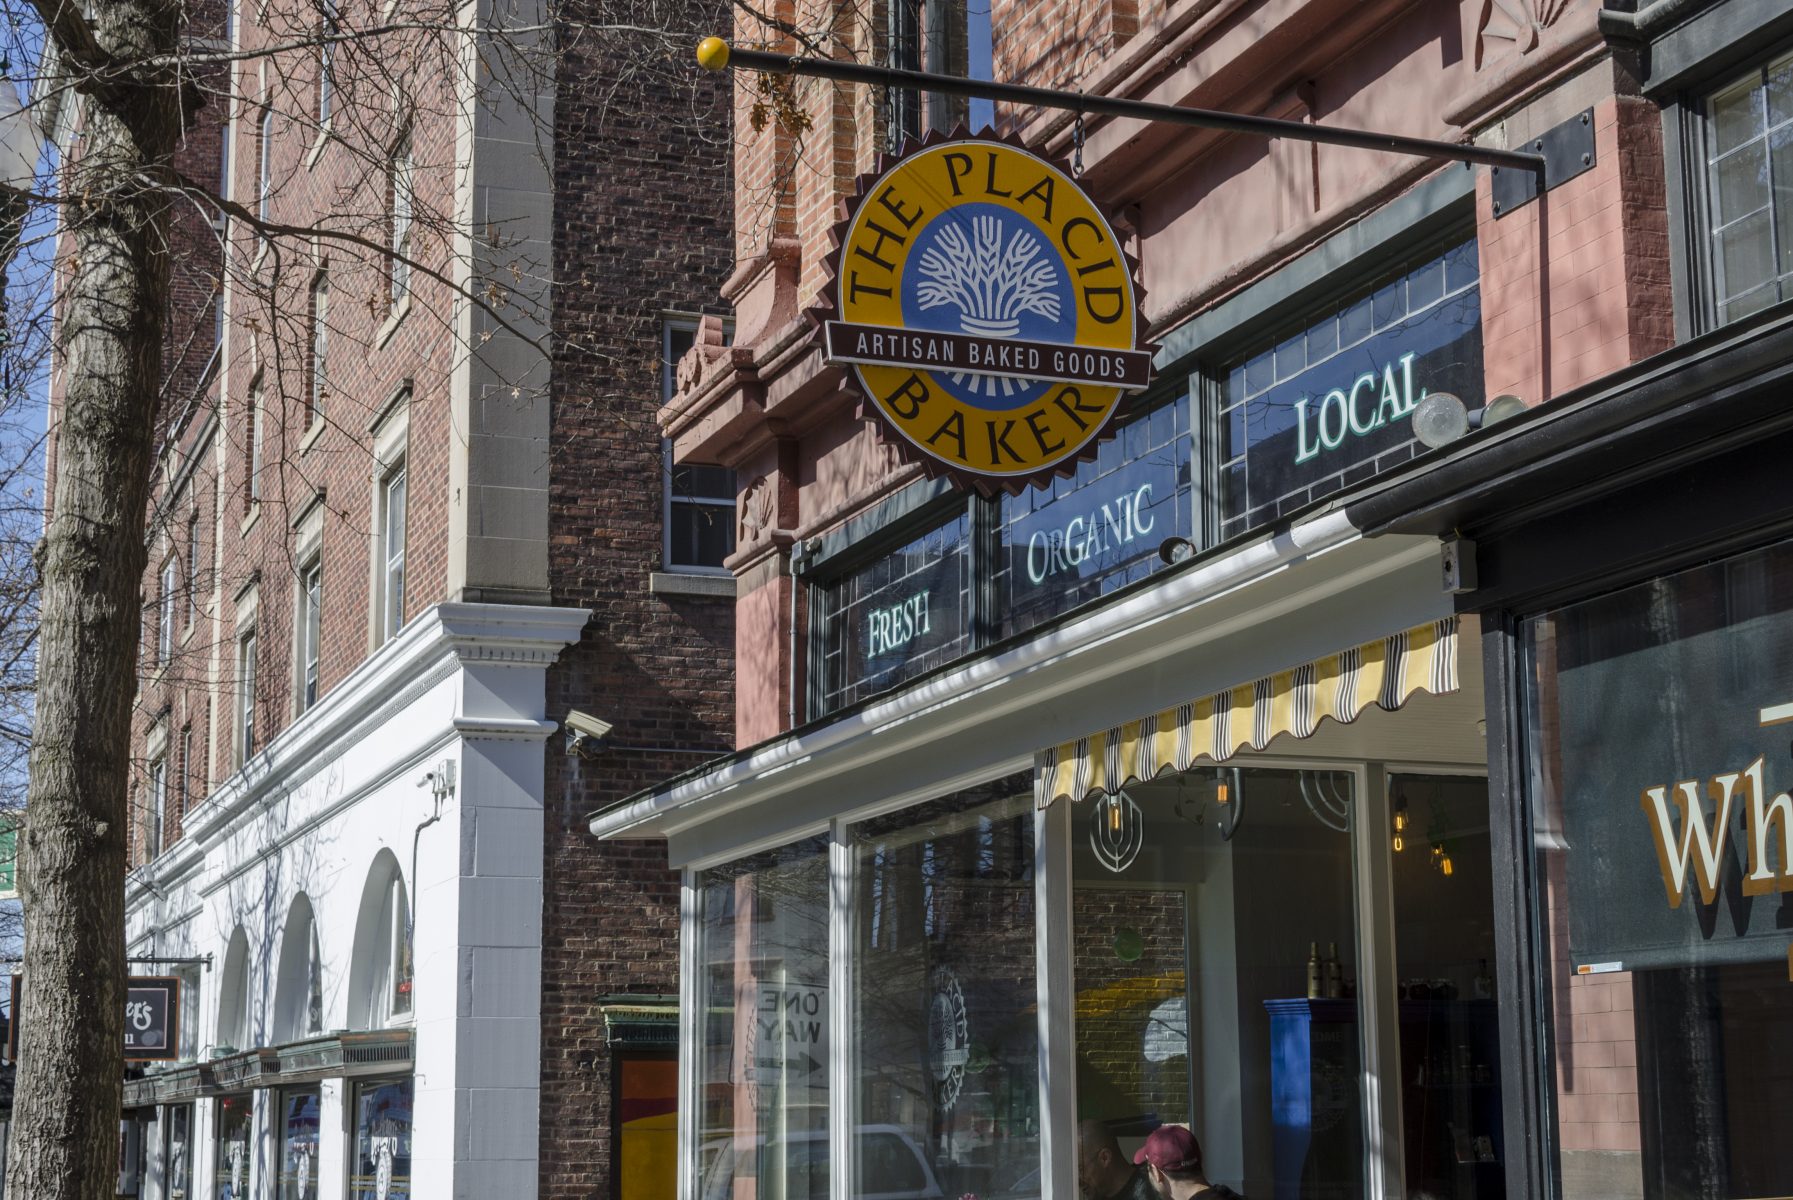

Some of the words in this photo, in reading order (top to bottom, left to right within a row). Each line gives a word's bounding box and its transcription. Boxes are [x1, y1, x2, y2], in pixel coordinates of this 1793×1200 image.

[850, 186, 925, 305] THE
[943, 152, 1124, 325] PLACID
[856, 331, 955, 363] ARTISAN
[969, 342, 1040, 370] BAKED
[1053, 350, 1126, 379] GOODS
[885, 371, 1106, 465] BAKER
[1294, 351, 1427, 465] LOCAL
[1027, 483, 1155, 585] ORGANIC
[867, 589, 932, 660] FRESH
[125, 1000, 153, 1031] er's
